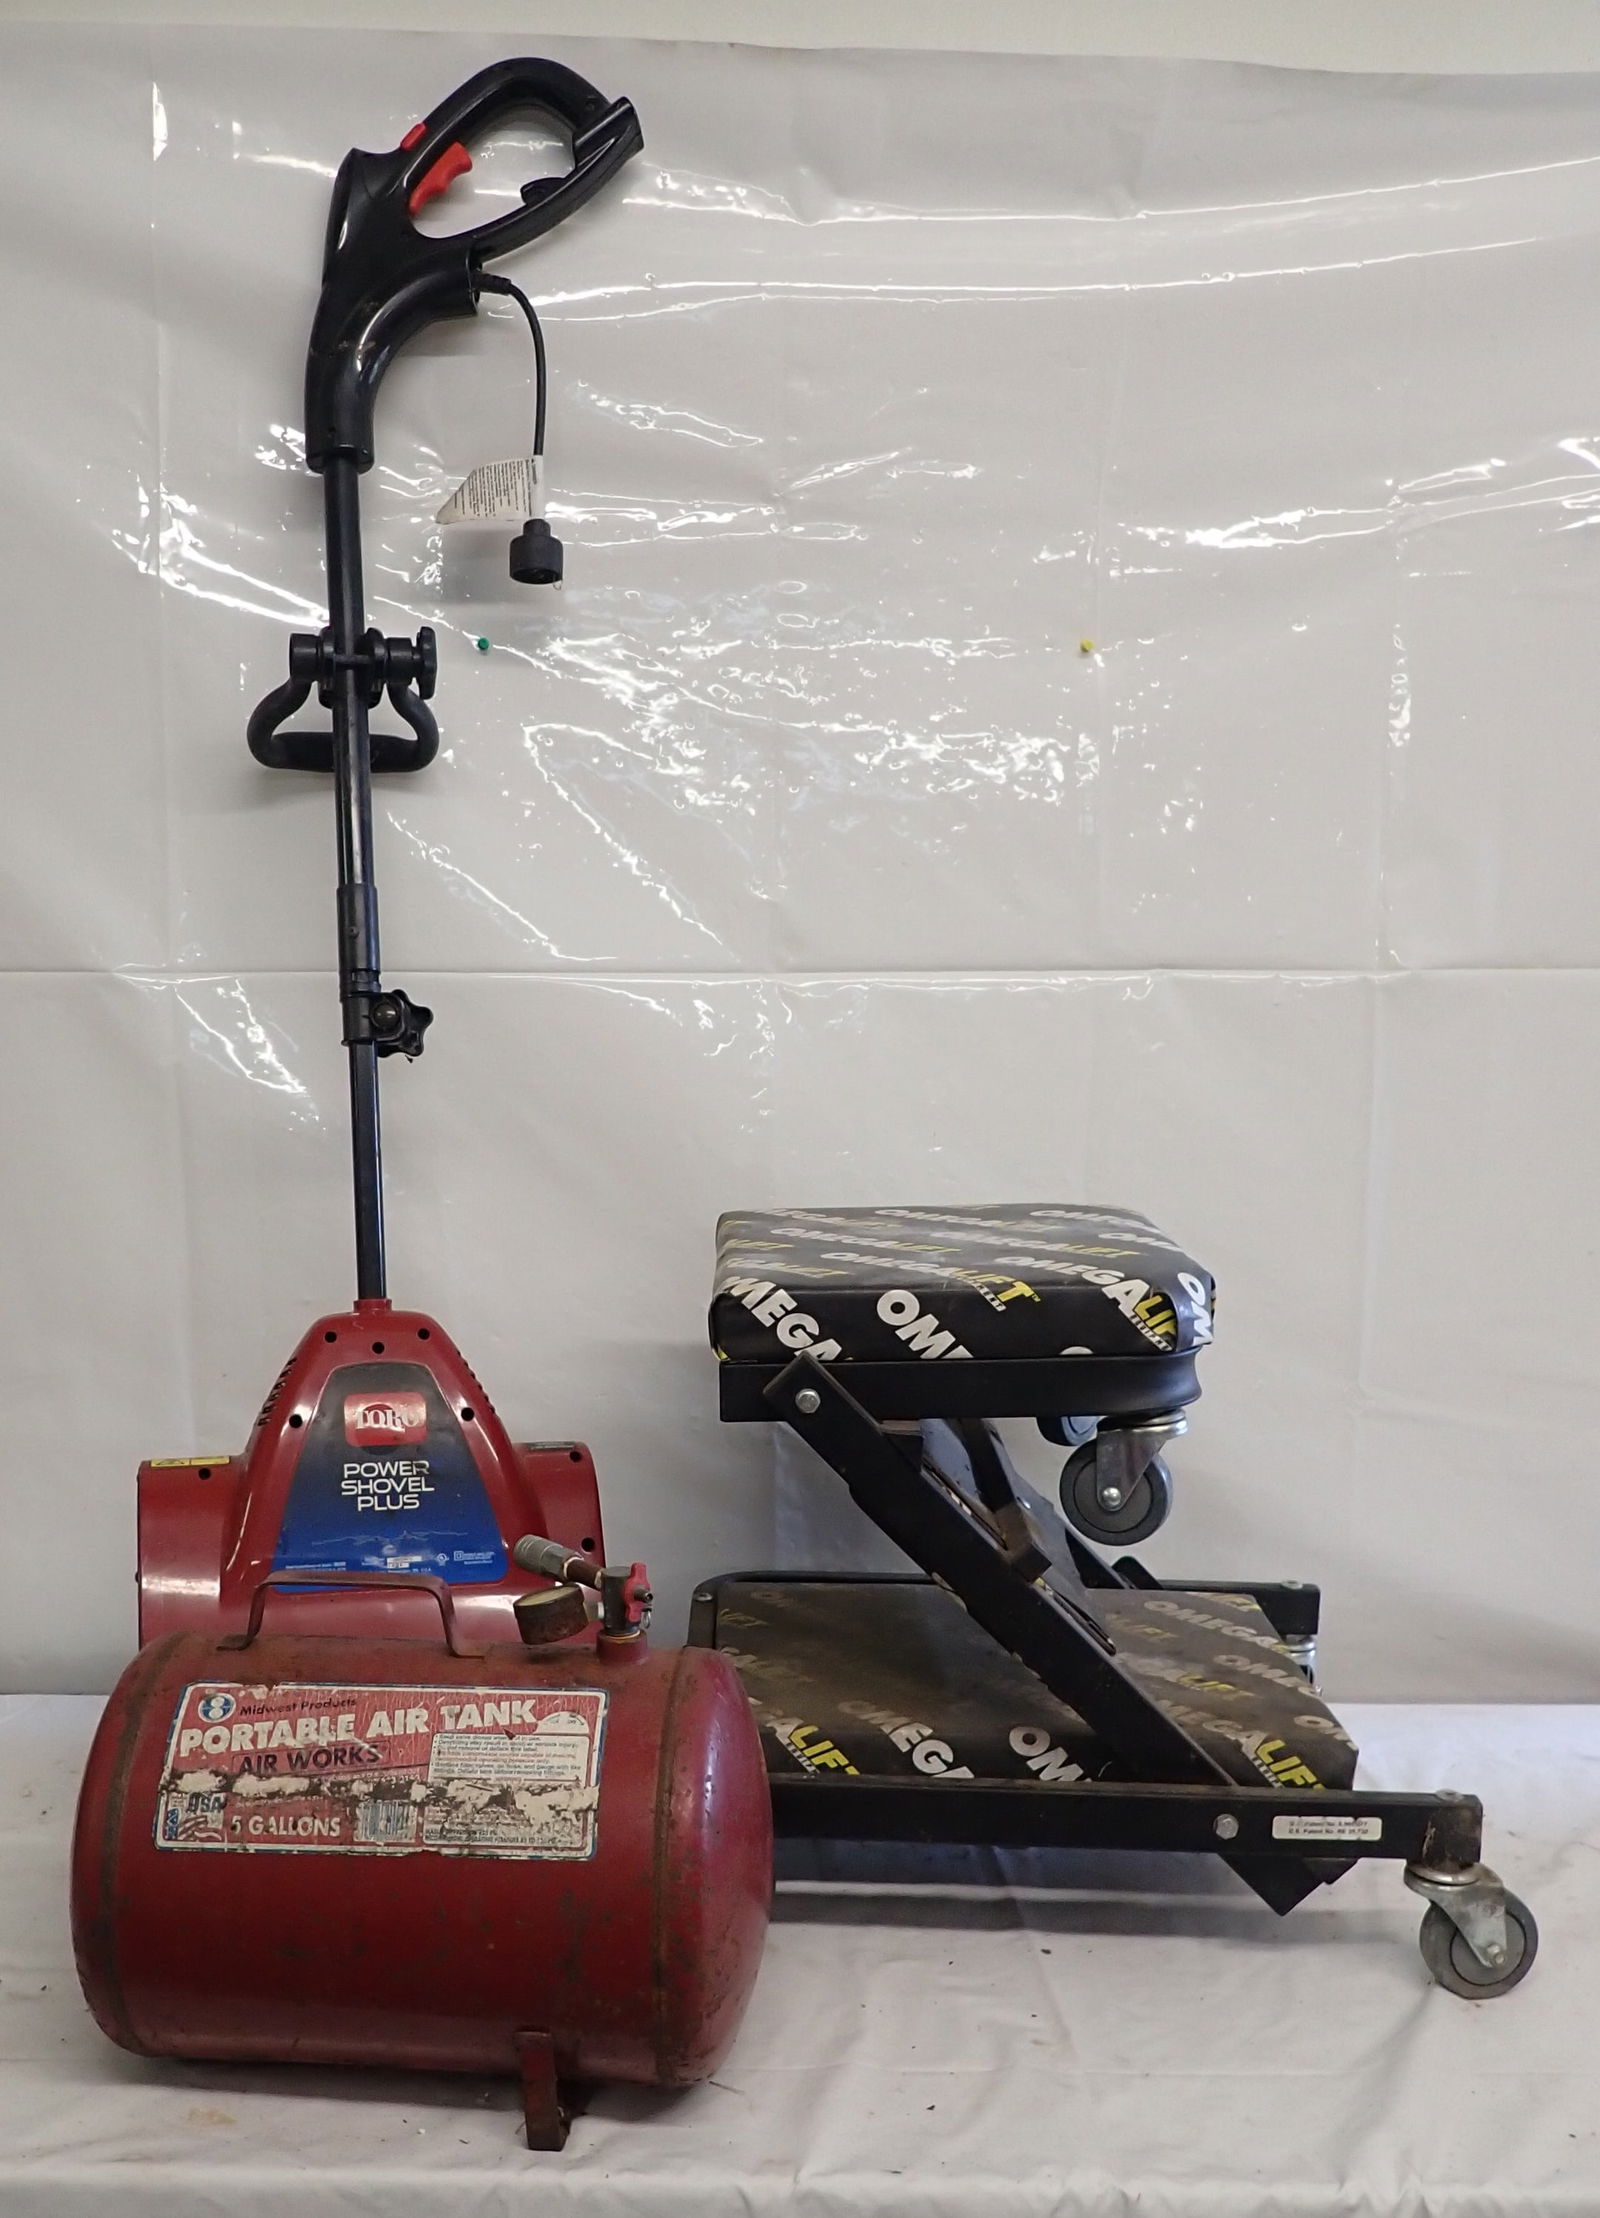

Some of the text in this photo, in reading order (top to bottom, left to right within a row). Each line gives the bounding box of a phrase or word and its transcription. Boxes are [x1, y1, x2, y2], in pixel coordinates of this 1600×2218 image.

[343, 1460, 430, 1479] POWER
[341, 1476, 436, 1496] SHOVEL
[357, 1493, 421, 1512] PLUS
[239, 1698, 357, 1716] Midwest Products
[180, 1713, 356, 1757] PORTABLE
[366, 1708, 430, 1739] AIR
[440, 1699, 538, 1732] TANK
[239, 1744, 381, 1776] AIR WORKS
[231, 1814, 341, 1837] 5 GALLONS
